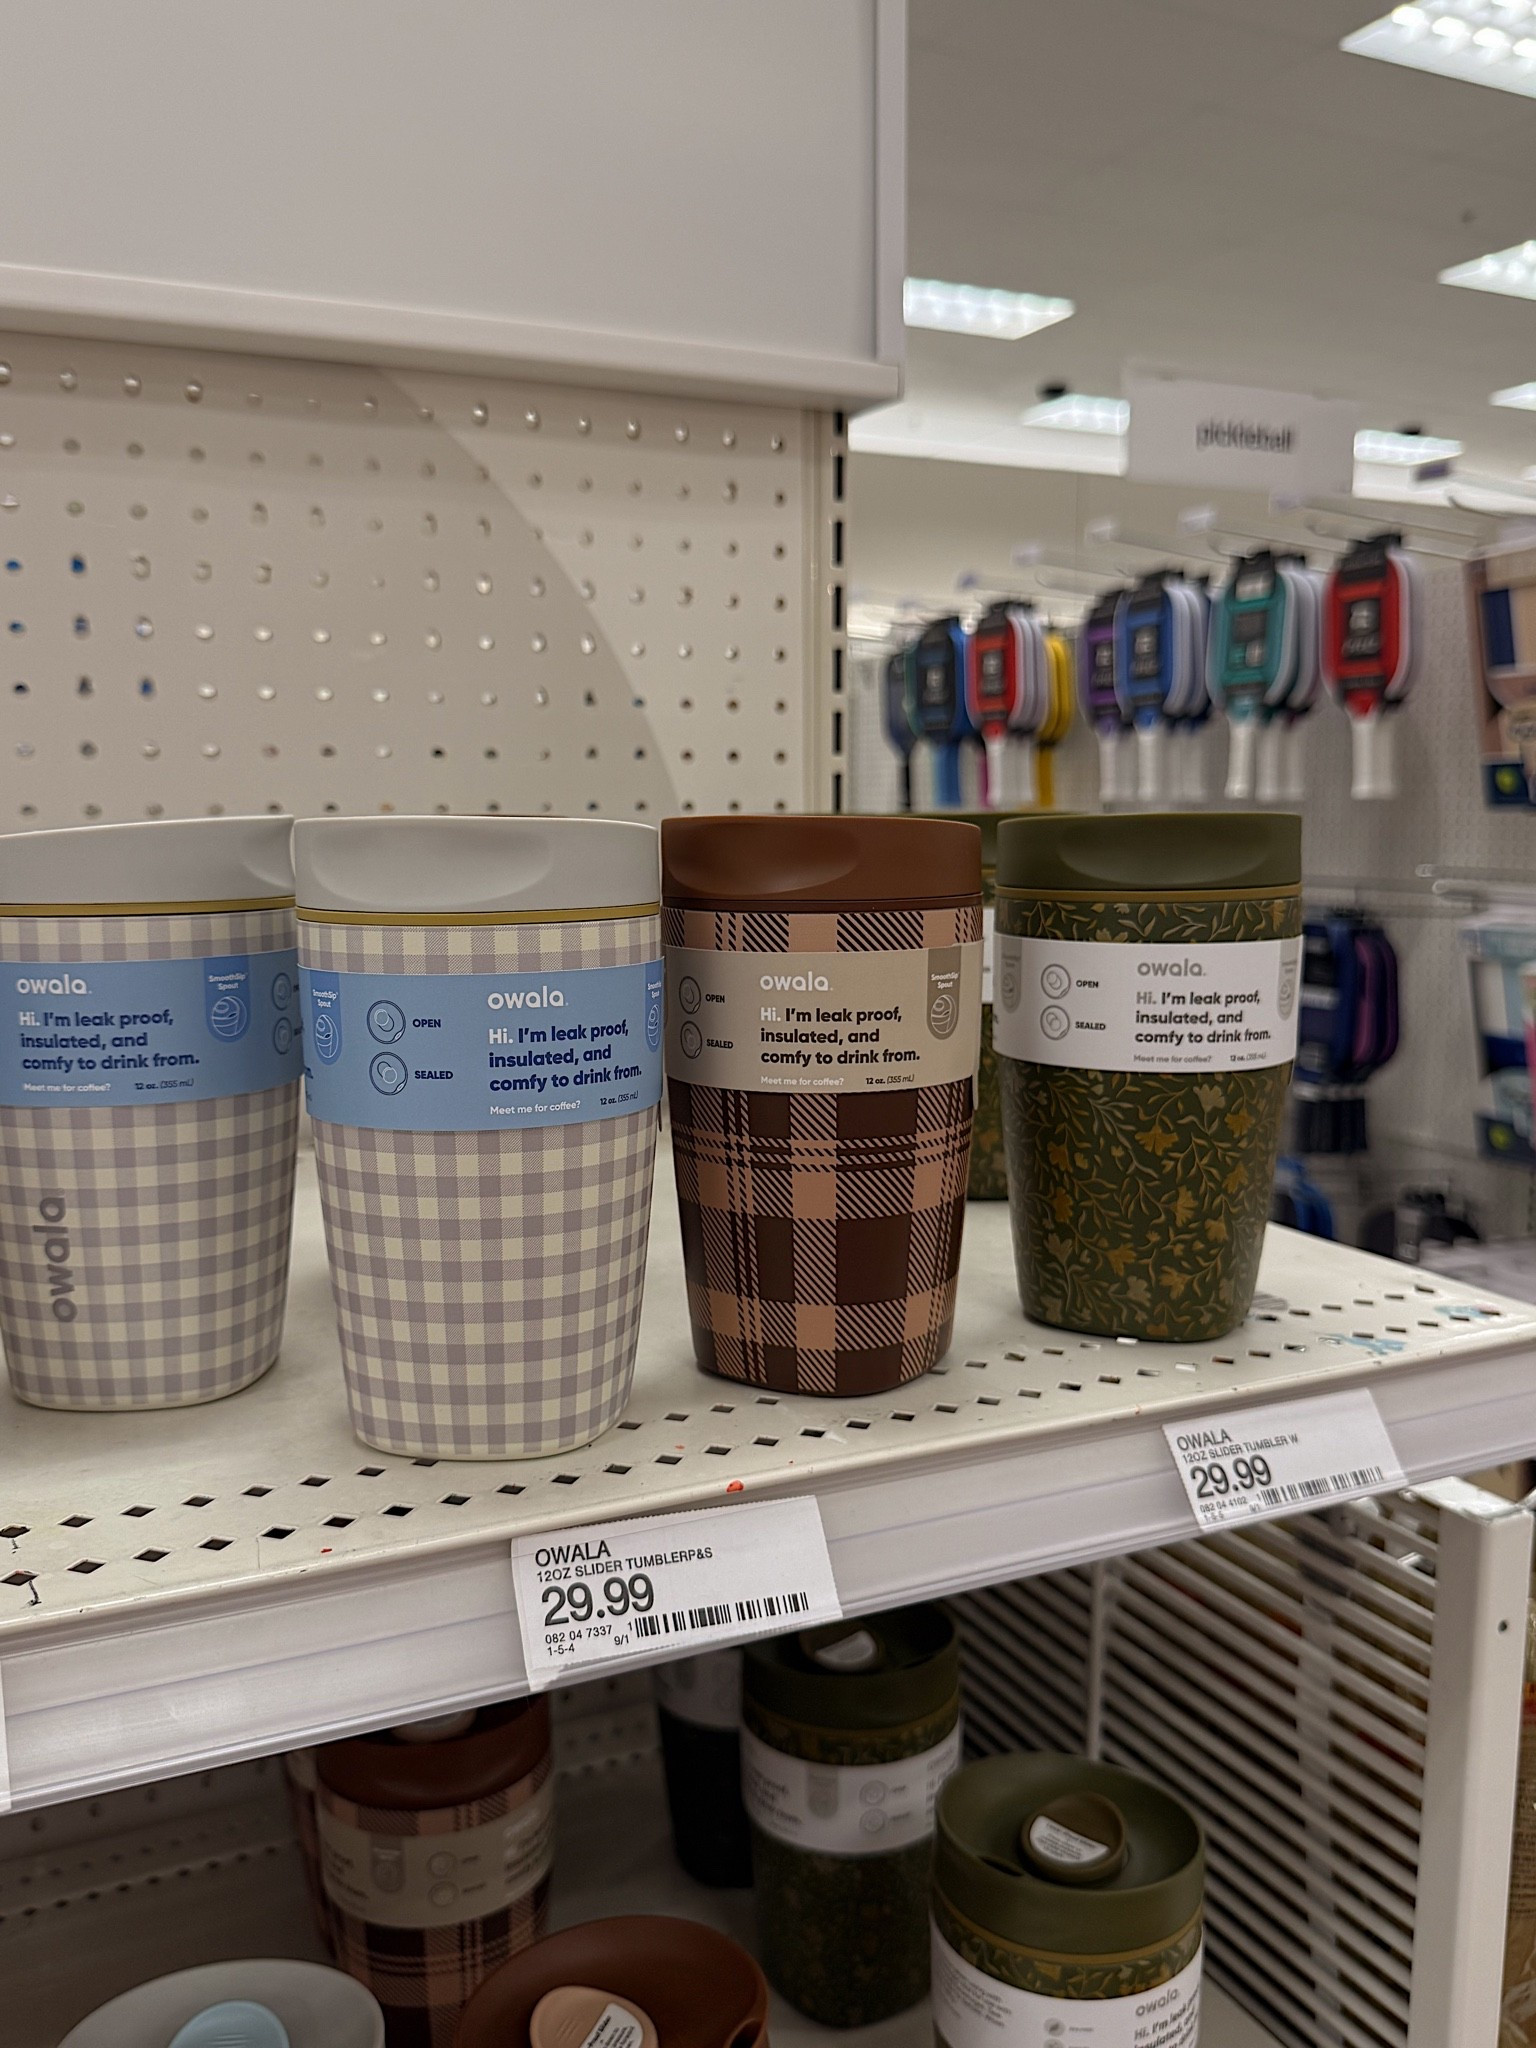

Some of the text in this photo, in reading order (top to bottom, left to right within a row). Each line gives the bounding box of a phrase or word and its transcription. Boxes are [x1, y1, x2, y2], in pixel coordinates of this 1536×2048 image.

[1076, 980, 1099, 988] OPEN
[705, 994, 725, 1003] OPEN
[1136, 990, 1260, 1007] Hi. I'm leak proof,
[18, 1009, 173, 1029] Hi. I'm leak proof,
[412, 1018, 441, 1028] OPEN
[760, 1006, 902, 1025] Hi. I'm leak proof,
[1136, 1011, 1243, 1026] insulated, and
[489, 1019, 628, 1044] Hi. I'm leak proof,
[1075, 1021, 1106, 1031] SEALED
[20, 1032, 148, 1050] insulated, and
[706, 1039, 733, 1049] SEALED
[761, 1028, 879, 1045] insulated, and
[1135, 1028, 1271, 1046] comfy to drink from.
[22, 1053, 200, 1073] comfy to drink from.
[489, 1044, 612, 1068] insulated, and
[761, 1049, 920, 1067] comfy to drink from.
[414, 1070, 453, 1080] SEALED
[489, 1064, 642, 1093] comfy to drink from.
[761, 1076, 782, 1085] Meet
[799, 1077, 811, 1085] for
[813, 1077, 844, 1086] coffee?
[866, 1077, 874, 1085] 12
[887, 1076, 901, 1085] (355
[23, 1083, 46, 1092] Meet
[62, 1083, 76, 1092] for
[78, 1083, 111, 1092] coffee?
[608, 1096, 617, 1104] oz.
[617, 1093, 629, 1103] (355
[490, 1105, 515, 1115] Meet
[535, 1103, 548, 1113] for
[549, 1100, 581, 1111] coffee?
[1177, 1429, 1231, 1451] OWALA
[1183, 1434, 1298, 1464] 12OZ SLIDER TUMBLER W
[1190, 1454, 1271, 1498] 29.99
[1200, 1496, 1248, 1512] 082 04 4102
[535, 1540, 611, 1566] OWALA
[537, 1547, 713, 1583] 12OZ SLIDER TUMBLERP&S
[542, 1573, 654, 1626] 29.99
[545, 1625, 612, 1645] 082 04 7337
[614, 1634, 629, 1645] 9/1
[548, 1644, 575, 1656] 1-5-4
